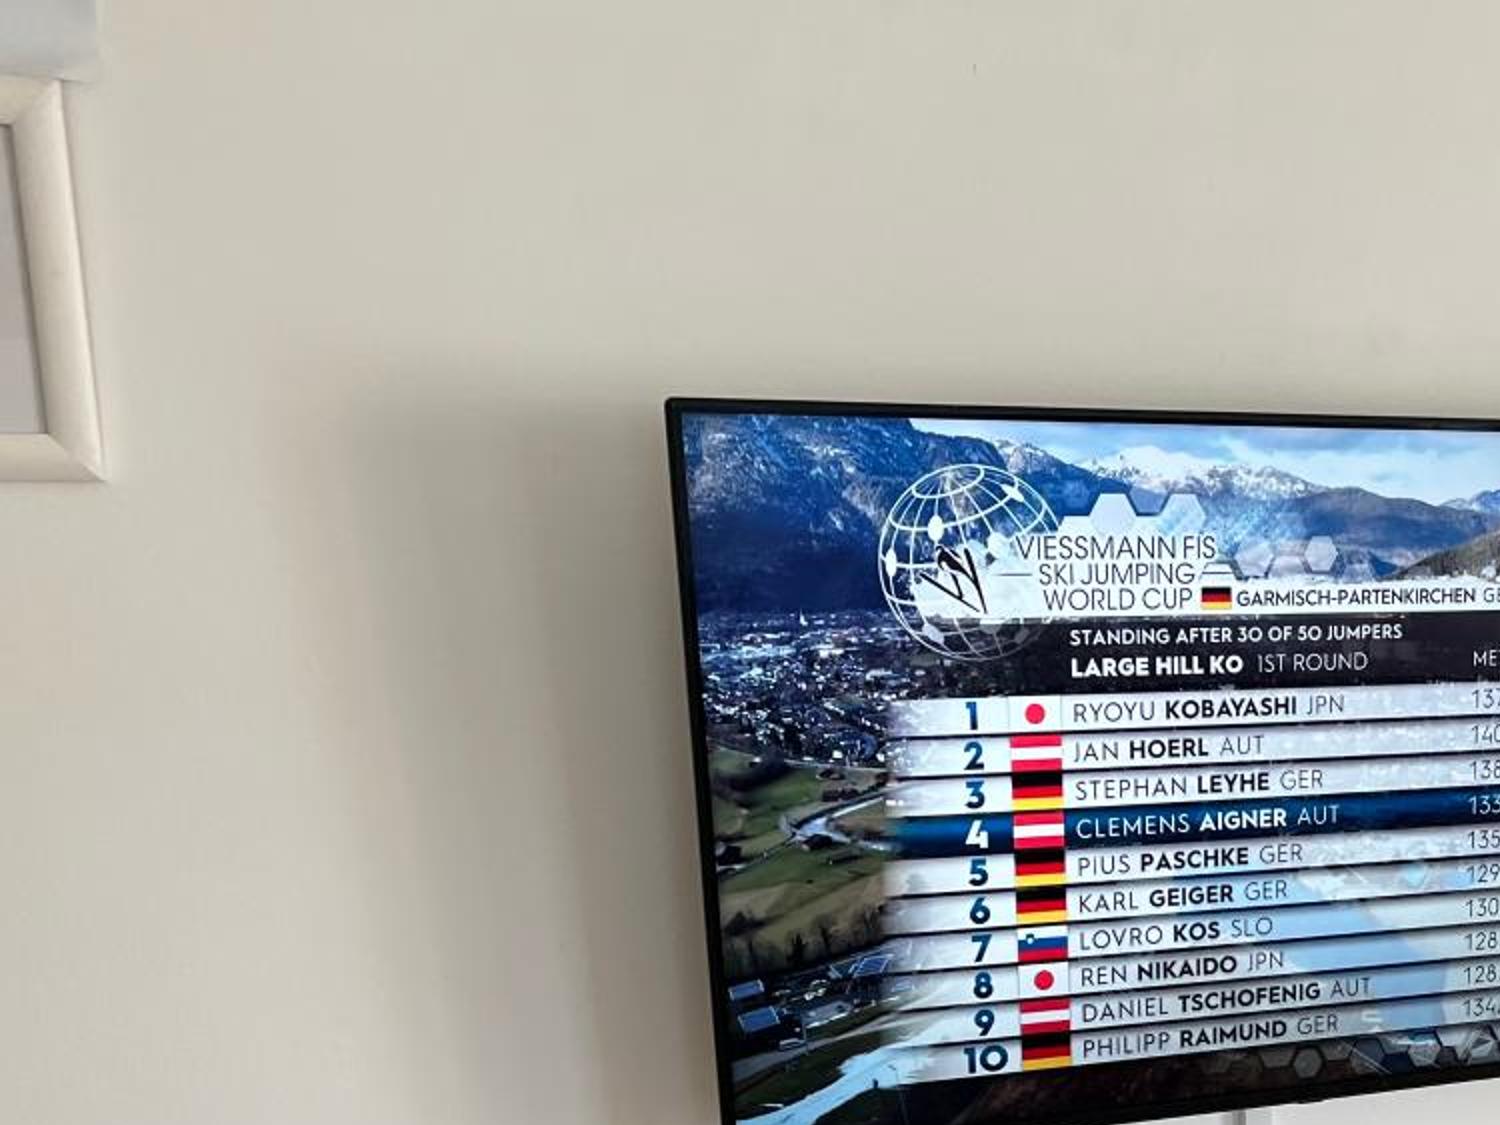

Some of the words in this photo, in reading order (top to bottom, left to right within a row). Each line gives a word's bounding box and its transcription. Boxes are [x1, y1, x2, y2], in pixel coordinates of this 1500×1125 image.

[1016, 536, 1177, 560] VIESSMANN
[1183, 536, 1216, 559] FIS
[1039, 563, 1074, 585] SKI
[1079, 562, 1195, 585] JUMPING
[1044, 589, 1134, 611] WORLD
[1143, 588, 1193, 609] CUP
[1237, 587, 1476, 607] GARMISCH-PARTENKIRCHEN
[1069, 629, 1171, 647] STANDING
[1177, 628, 1232, 644] AFTER
[1237, 628, 1262, 644] 30
[1268, 626, 1292, 642] OF
[1298, 626, 1322, 641] 50
[1327, 624, 1403, 641] JUMPERS
[1071, 657, 1150, 678] LARGE
[1156, 656, 1204, 676] HILL
[1210, 655, 1244, 675] KO
[1257, 654, 1287, 673] 1ST
[1293, 652, 1369, 671] ROUND
[965, 702, 979, 730] 1
[1073, 702, 1155, 724] RYOYU
[1165, 696, 1297, 720] KOBAYASHI
[1304, 695, 1345, 716] JPN
[963, 742, 985, 770] 2
[1073, 742, 1119, 763] JAN
[1129, 738, 1209, 759] HOERL
[1219, 736, 1264, 756] AUT
[964, 781, 985, 809] 3
[1075, 777, 1187, 801] STEPHAN
[1197, 773, 1270, 795] LEYHE
[1279, 769, 1324, 790] GER
[965, 820, 989, 849] 4
[1076, 813, 1190, 840] CLEMENS
[1199, 809, 1287, 833] AIGNER
[1296, 805, 1340, 825] AUT
[968, 859, 989, 887] 5
[1078, 854, 1131, 877] PIUS
[1140, 848, 1249, 872] PASCHKE
[1259, 843, 1303, 864] GER
[969, 897, 991, 925] 6
[1078, 891, 1139, 914] KARL
[1149, 885, 1234, 908] GEIGER
[1244, 881, 1288, 901] GER
[971, 934, 992, 963] 7
[1079, 925, 1163, 952] LOVRO
[1173, 922, 1221, 943] KOS
[1230, 917, 1273, 937] SLO
[973, 971, 994, 1000] 8
[1081, 966, 1128, 987] REN
[1137, 955, 1237, 982] NIKAIDO
[1246, 951, 1285, 972] JPN
[974, 1009, 996, 1037] 9
[1082, 998, 1169, 1024] DANIEL
[1178, 983, 1321, 1014] TSCHOFENIG
[1329, 977, 1371, 998] AUT
[963, 1045, 1009, 1074] 10
[1083, 1031, 1170, 1059] PHILIPP
[1179, 1020, 1287, 1047] RAIMUND
[1296, 1014, 1339, 1035] GER
